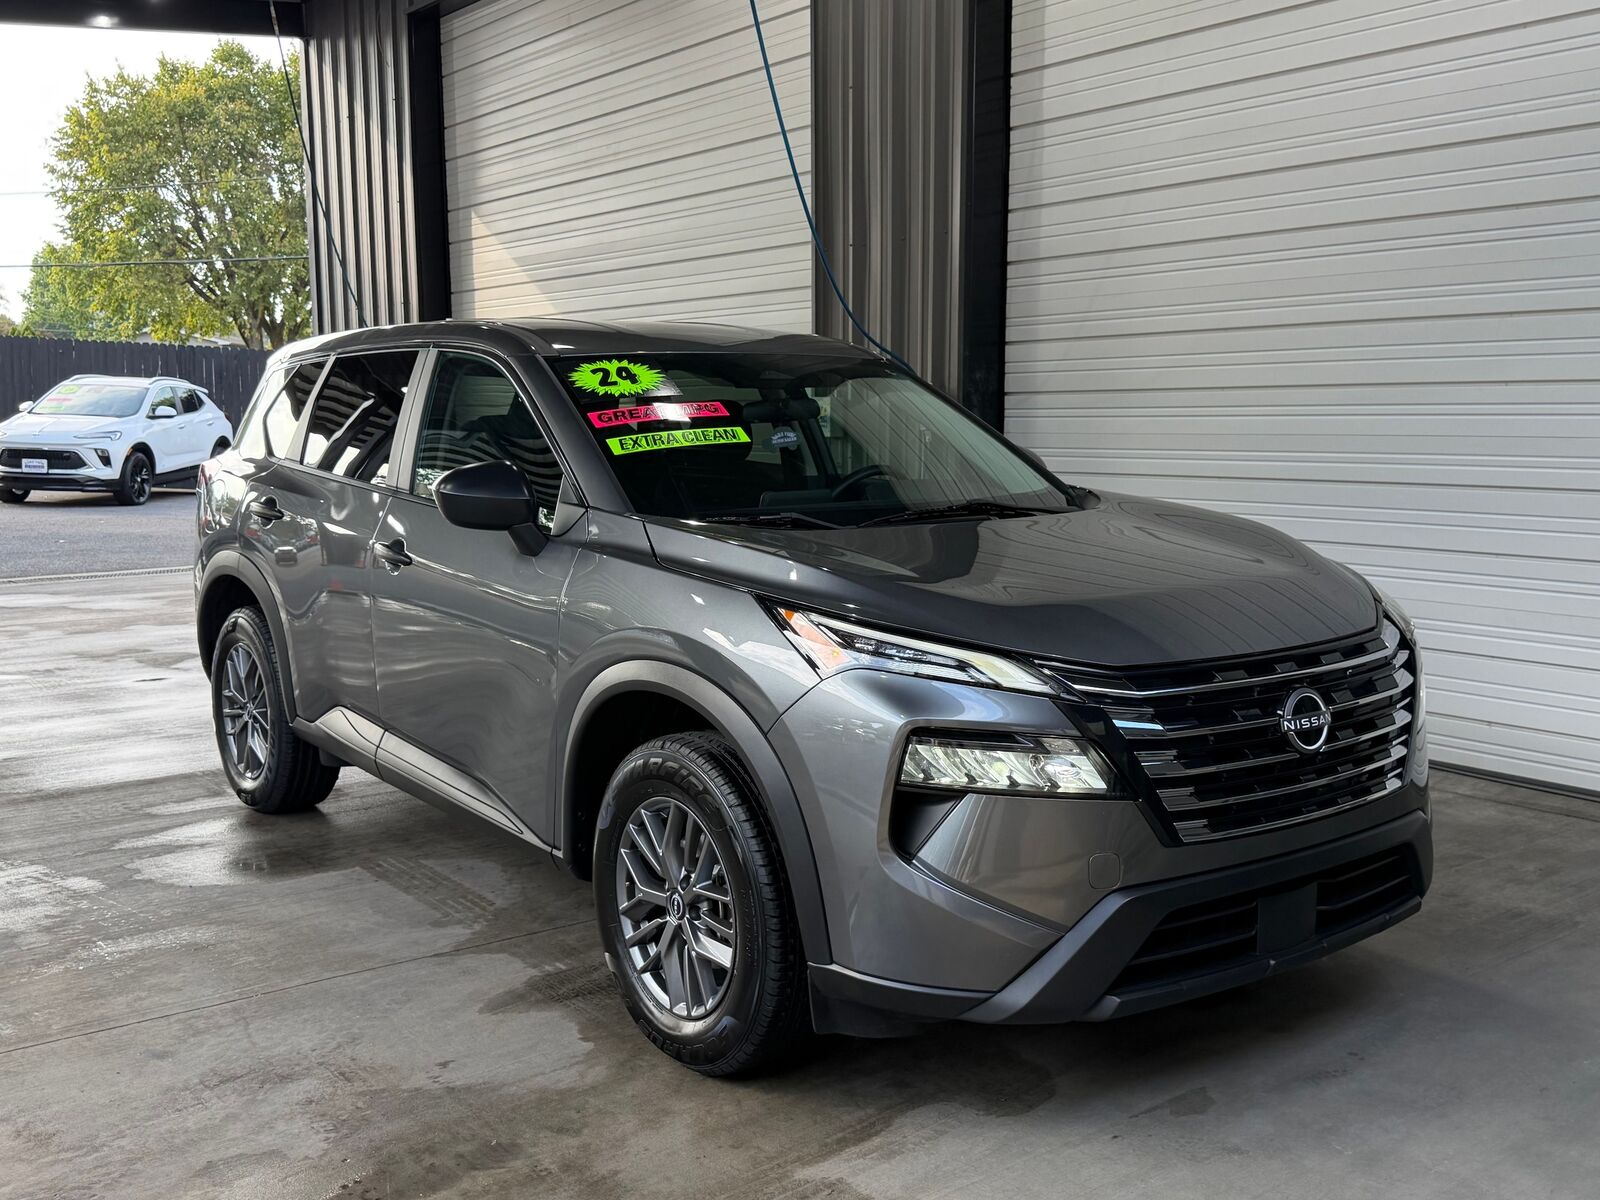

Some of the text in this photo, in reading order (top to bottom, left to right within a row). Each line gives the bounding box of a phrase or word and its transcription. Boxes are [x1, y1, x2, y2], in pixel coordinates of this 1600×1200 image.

[590, 366, 640, 387] 24
[597, 405, 668, 424] GREA
[618, 428, 738, 451] EXTRA CLEAN
[1283, 713, 1331, 731] NISSAN
